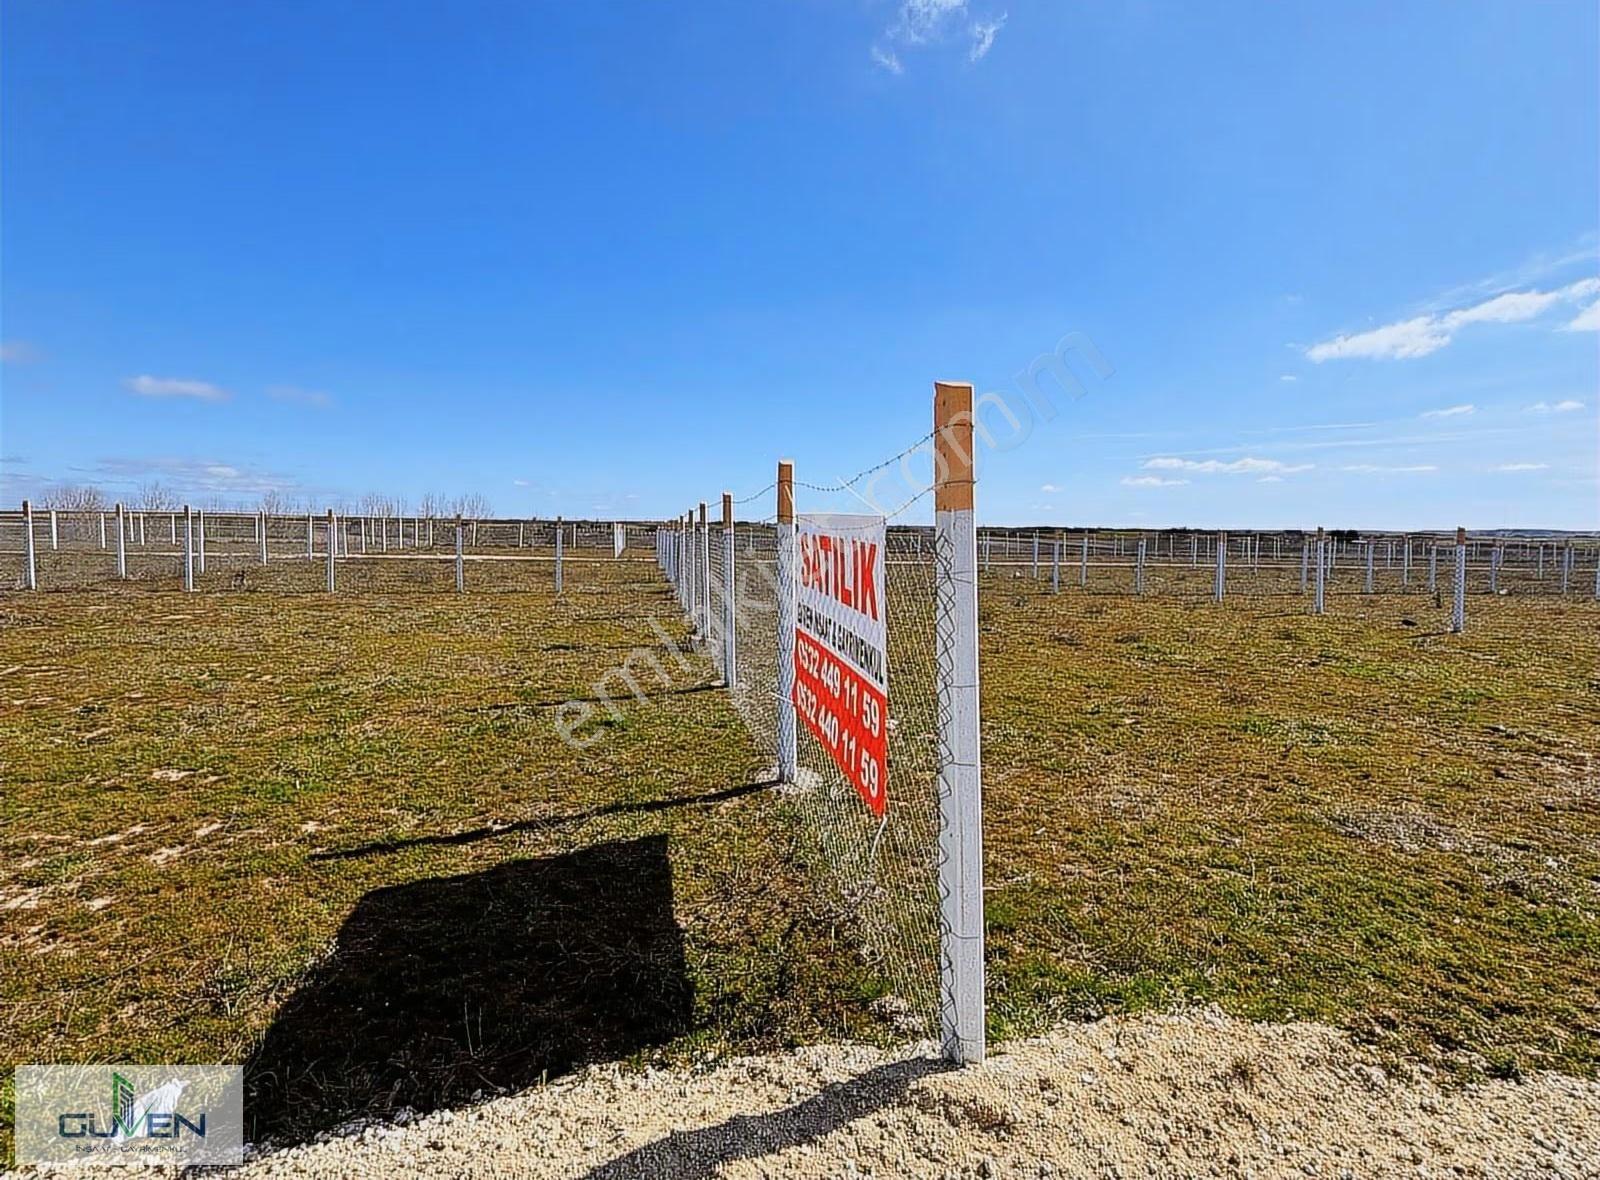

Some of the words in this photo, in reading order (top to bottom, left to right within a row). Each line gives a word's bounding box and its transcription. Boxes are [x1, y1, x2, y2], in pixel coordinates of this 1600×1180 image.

[800, 532, 878, 622] SATILIK
[798, 637, 820, 680] 0532
[820, 656, 840, 699] 449
[844, 675, 858, 718] 11
[862, 690, 880, 738] 59
[797, 679, 817, 725] 0532
[818, 704, 839, 749] 440
[842, 728, 856, 773] 11
[860, 748, 879, 798] 59
